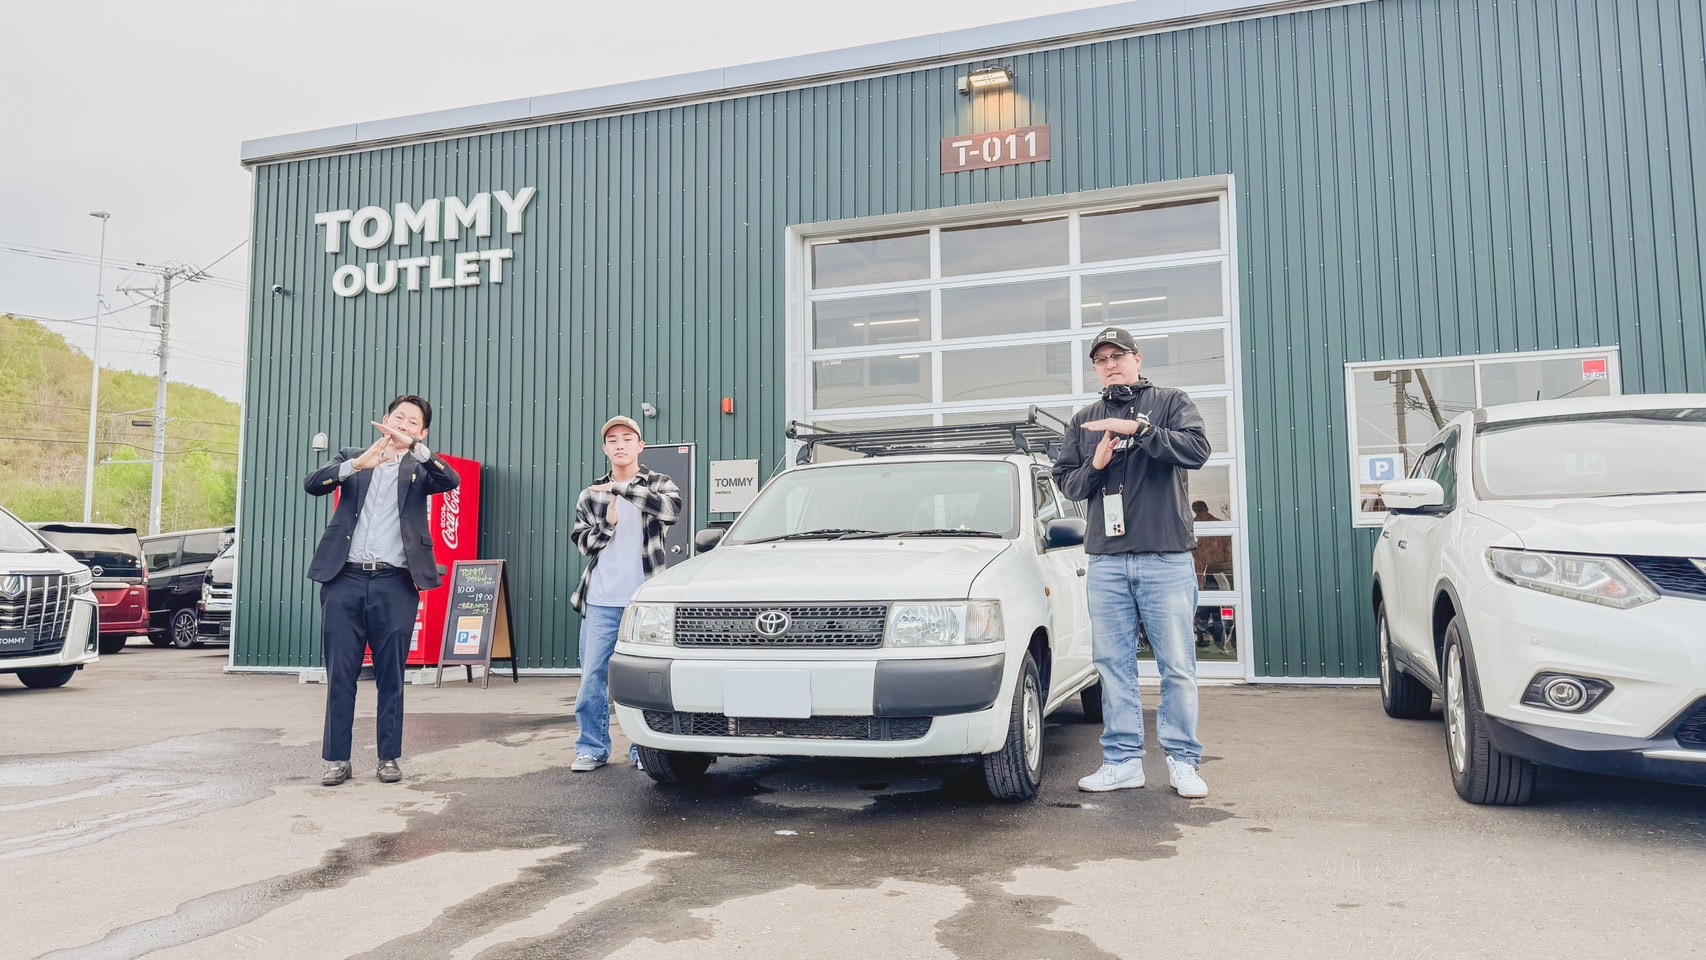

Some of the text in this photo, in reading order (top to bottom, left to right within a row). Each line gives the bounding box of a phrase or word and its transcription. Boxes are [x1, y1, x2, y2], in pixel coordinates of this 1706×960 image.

[952, 131, 1036, 166] T-011
[315, 186, 537, 253] TOMMY
[332, 248, 513, 298] OUTLET
[1375, 461, 1389, 478] P
[714, 477, 753, 487] TOMMY
[442, 483, 461, 549] Coca-Co
[459, 566, 485, 576] TOMMY
[457, 585, 475, 594] 1000
[0, 637, 26, 645] TOMMY
[460, 632, 467, 642] P
